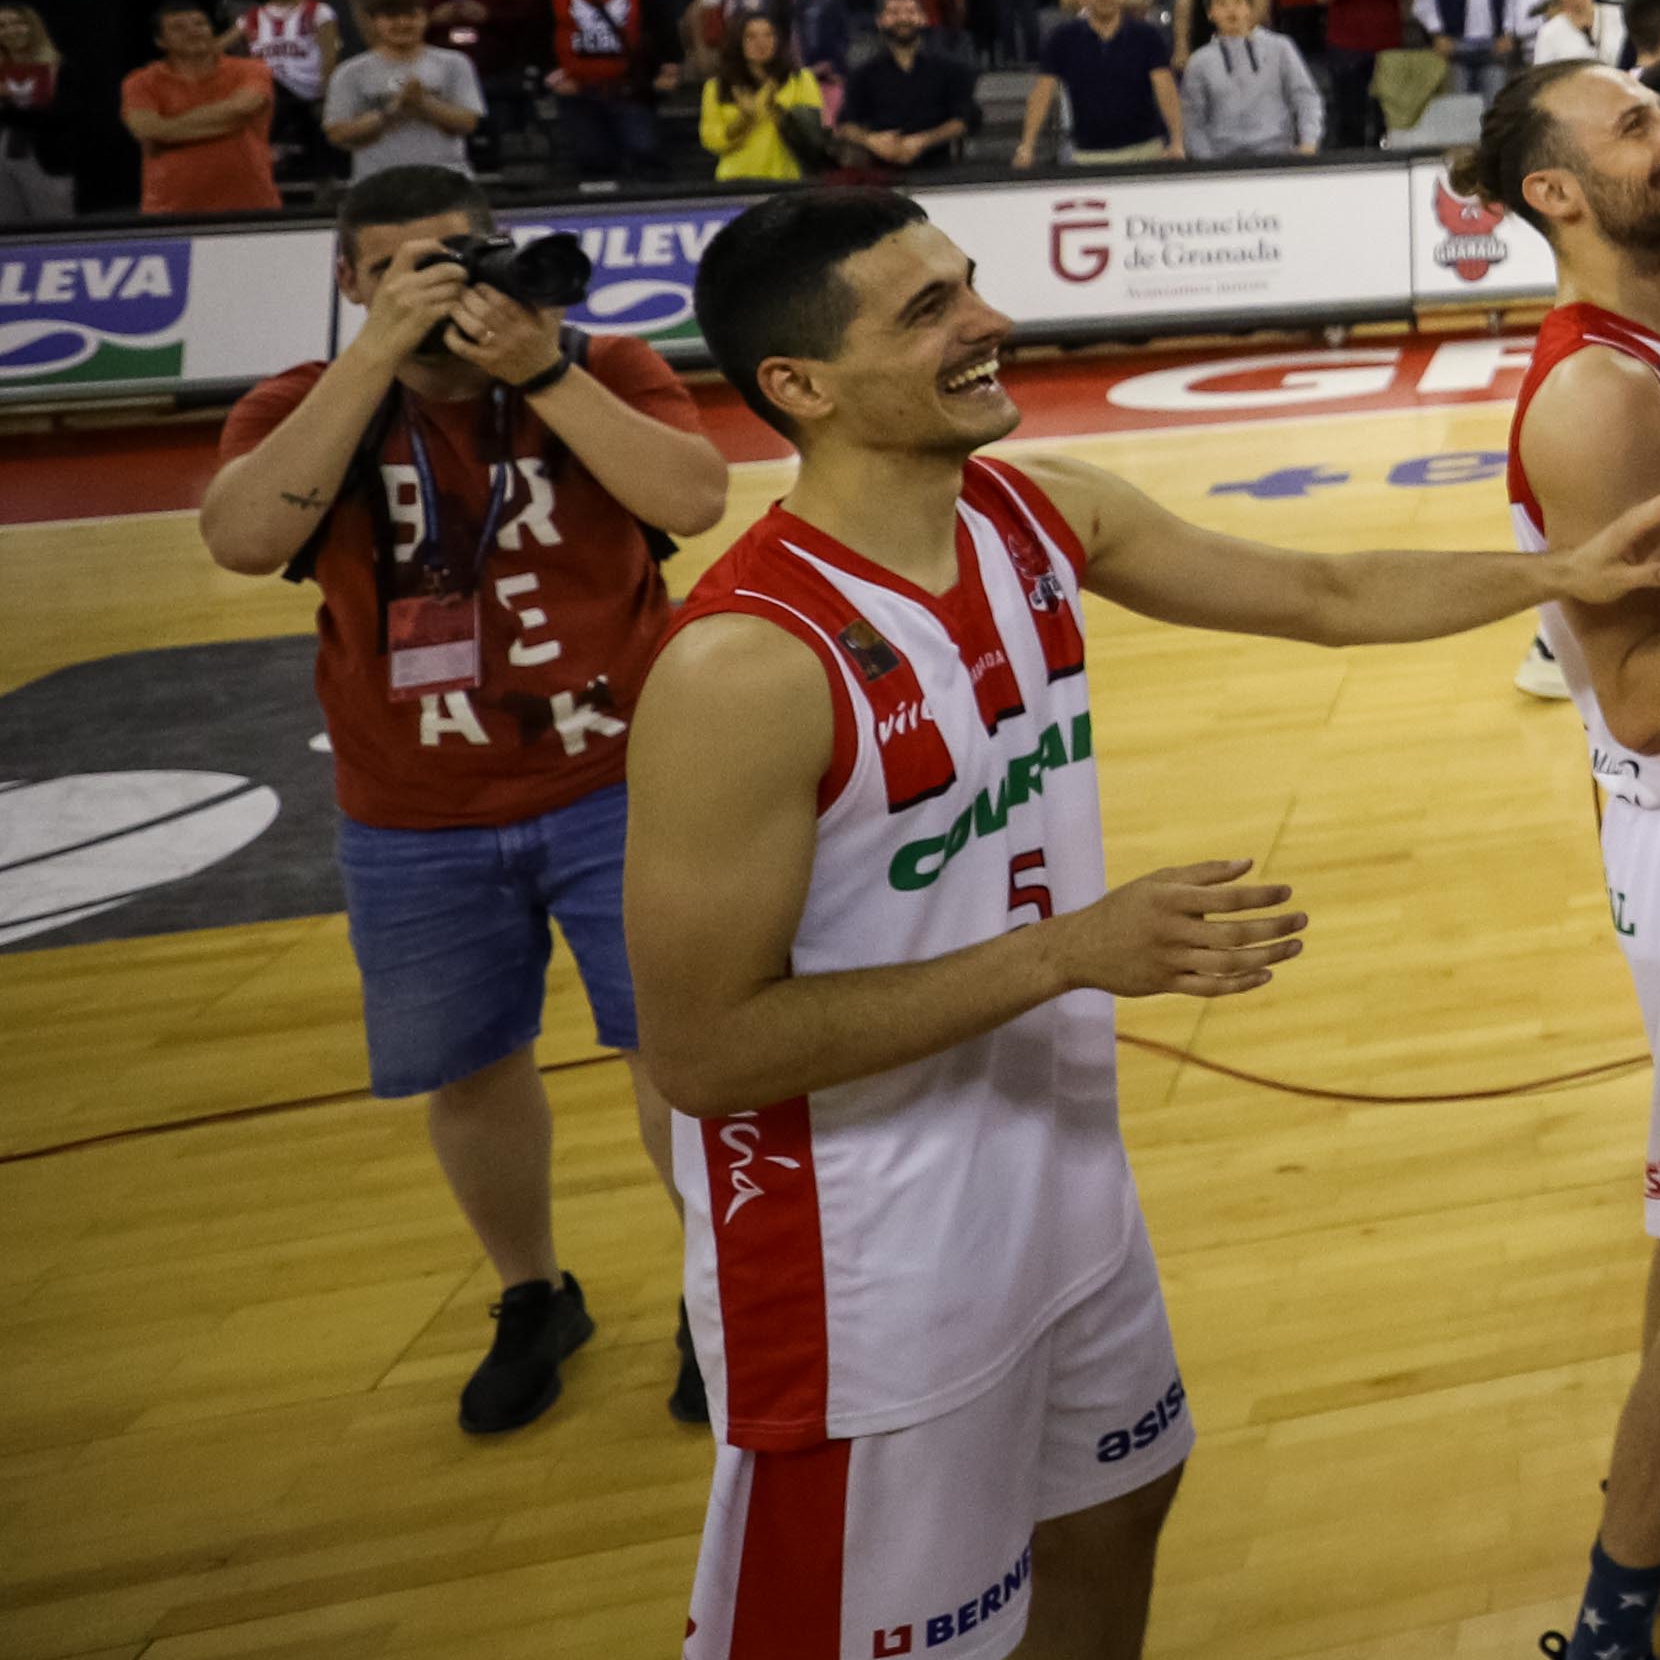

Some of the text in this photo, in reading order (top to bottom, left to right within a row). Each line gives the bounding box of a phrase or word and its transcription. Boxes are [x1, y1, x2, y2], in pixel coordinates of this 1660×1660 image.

[1125, 210, 1281, 241] Diputación
[1123, 237, 1281, 270] de Granada
[0, 254, 173, 305] LEVA
